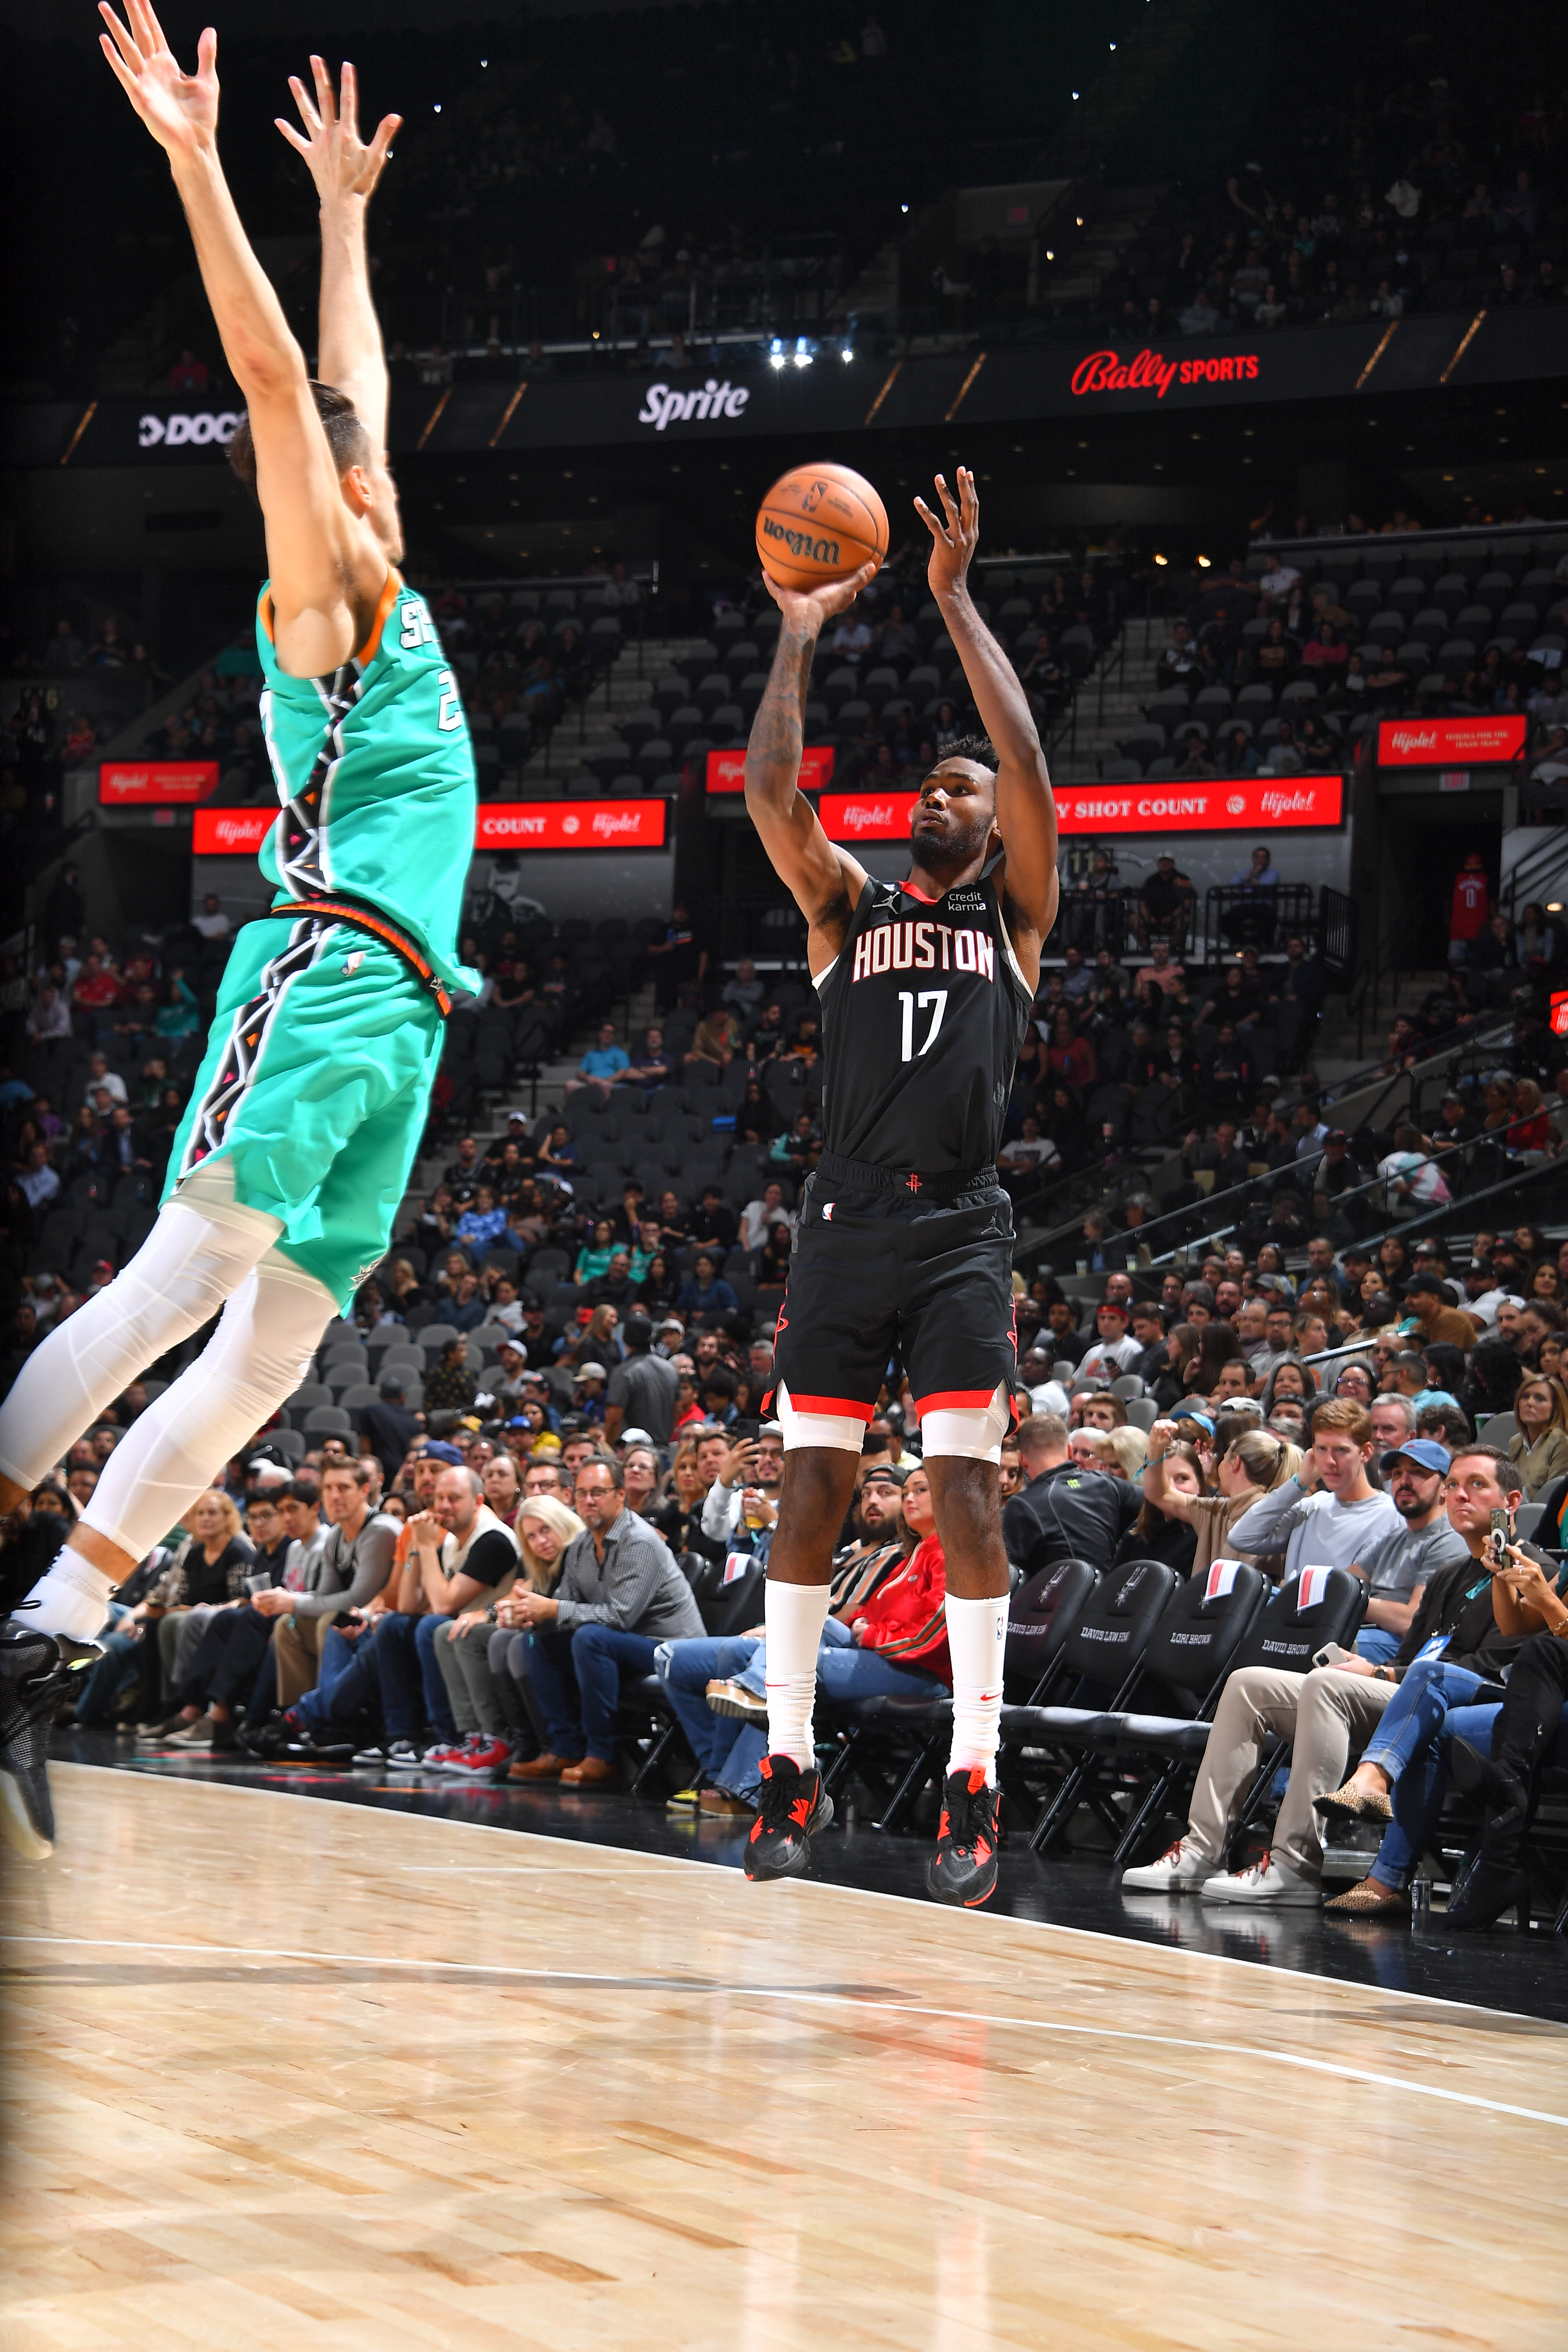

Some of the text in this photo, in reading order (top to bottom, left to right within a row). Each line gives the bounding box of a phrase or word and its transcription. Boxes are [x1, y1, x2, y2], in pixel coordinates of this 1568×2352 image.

[1071, 348, 1259, 398] Bally SPORTS
[638, 378, 750, 431] Sprite
[165, 412, 245, 444] DOC
[764, 517, 840, 565] Wilson
[1445, 772, 1465, 789] EXIT
[1075, 800, 1132, 819] SHOT
[1137, 797, 1207, 816] COUNT
[482, 817, 547, 835] COUNT
[949, 891, 983, 901] credit
[948, 901, 987, 912] karma
[852, 921, 994, 984] HOUSTON
[898, 990, 948, 1062] 17
[1080, 1627, 1105, 1642] DAVIS
[1103, 1631, 1119, 1642] LAW
[1170, 1632, 1212, 1645] LORI BROWN
[1261, 1639, 1310, 1655] DAVID BROWN
